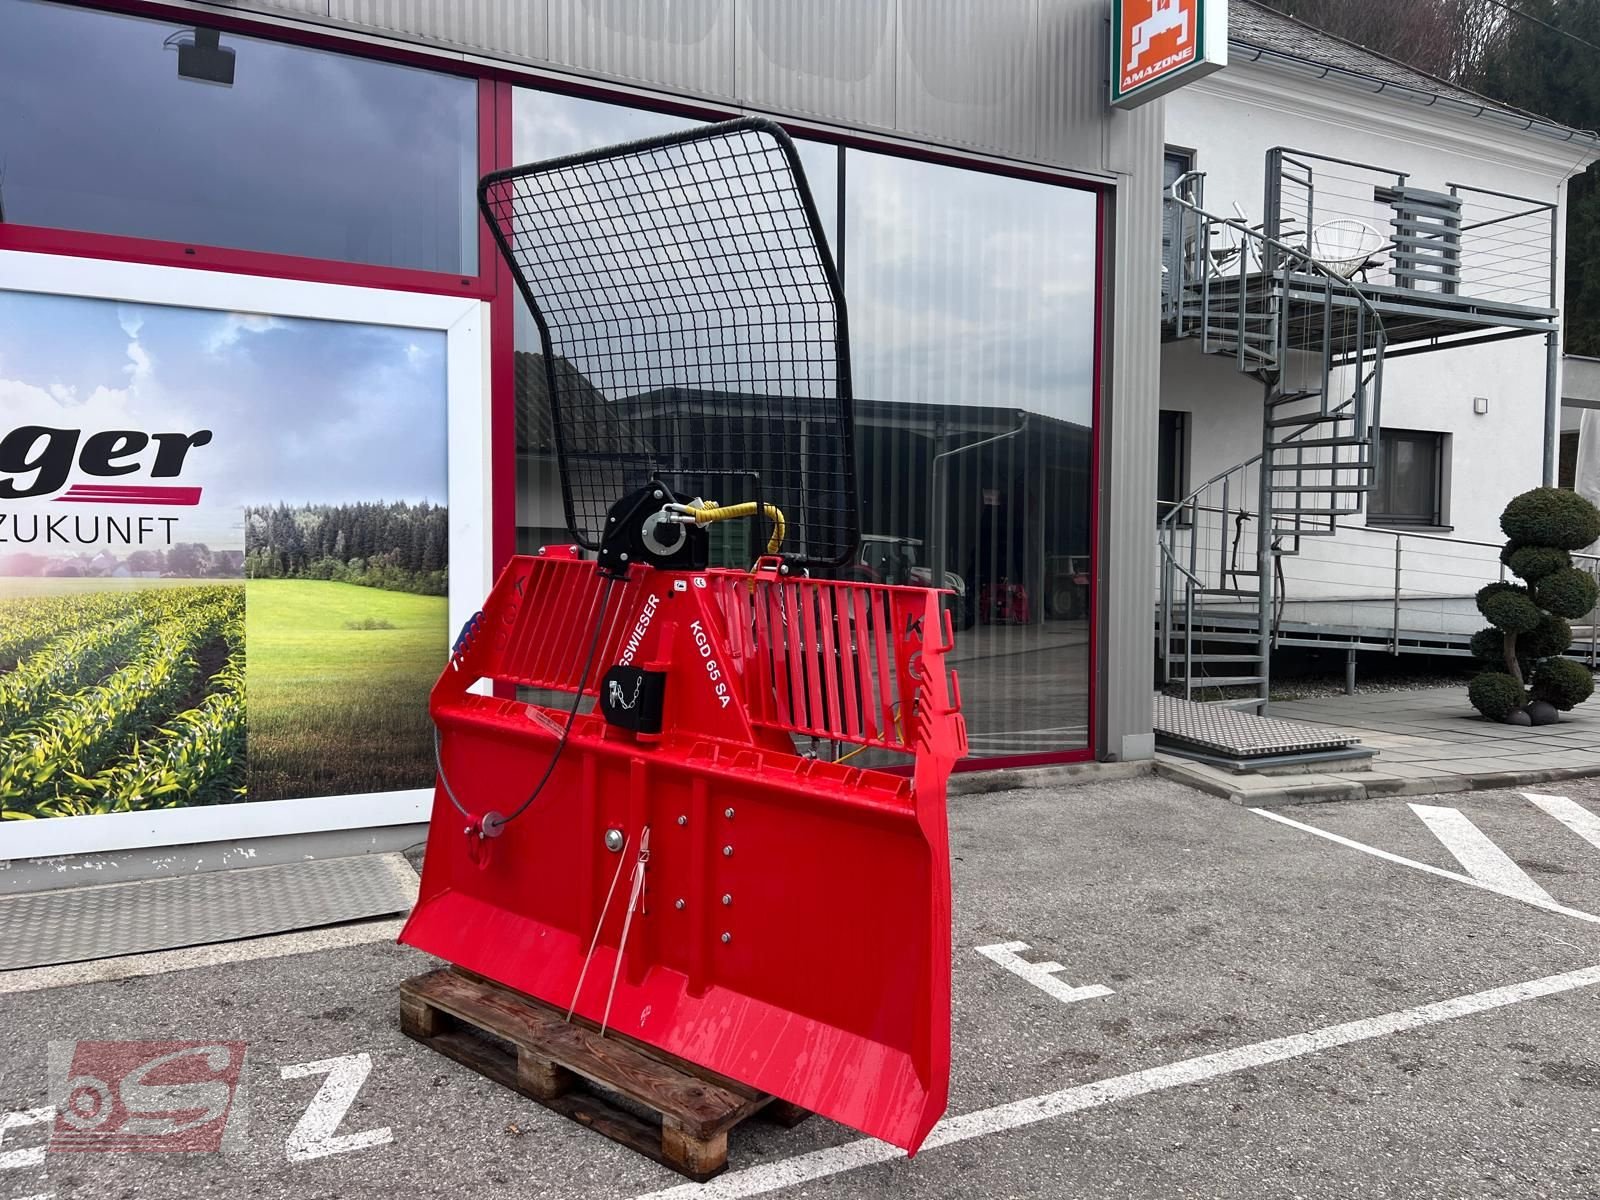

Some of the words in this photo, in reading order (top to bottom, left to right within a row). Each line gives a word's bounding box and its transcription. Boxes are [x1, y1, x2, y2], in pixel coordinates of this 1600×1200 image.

[1122, 46, 1193, 88] AMAZONE
[0, 425, 213, 499] ger
[690, 620, 712, 658] KGD
[706, 660, 721, 681] 65
[715, 682, 731, 709] SA
